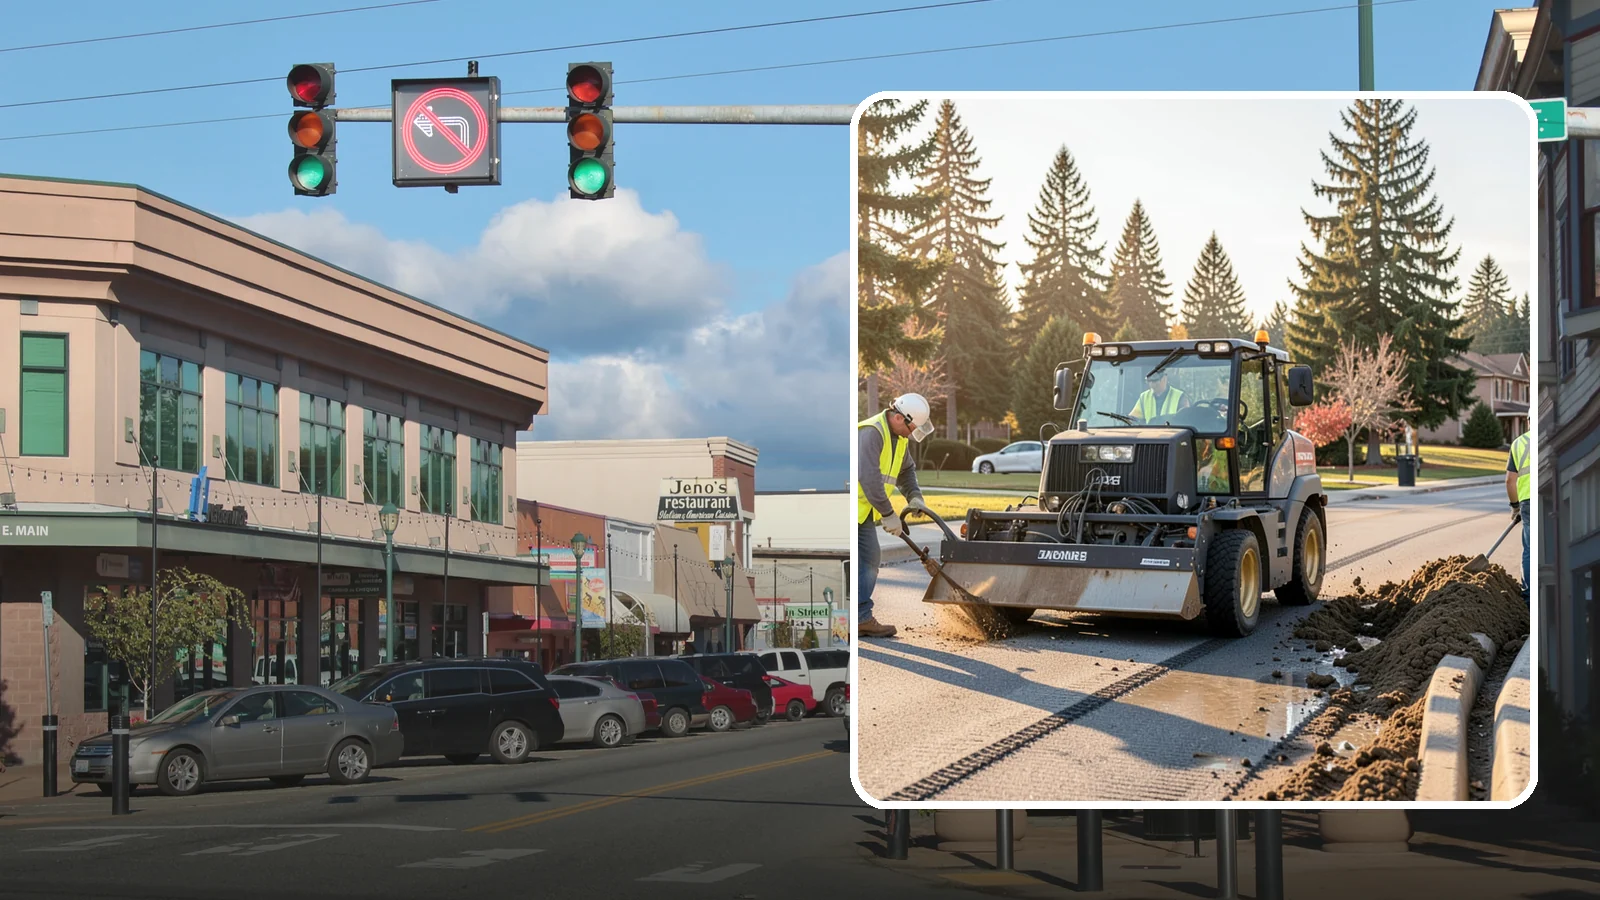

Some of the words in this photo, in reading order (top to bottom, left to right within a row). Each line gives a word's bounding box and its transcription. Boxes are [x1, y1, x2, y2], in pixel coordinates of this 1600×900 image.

[669, 480, 727, 495] Jeno's
[665, 496, 731, 509] restaurant
[658, 509, 681, 519] Italian
[685, 509, 714, 519] American
[715, 509, 737, 519] Cuisine
[2, 525, 13, 536] E.
[15, 525, 49, 536] MAIN
[797, 607, 829, 617] Street
